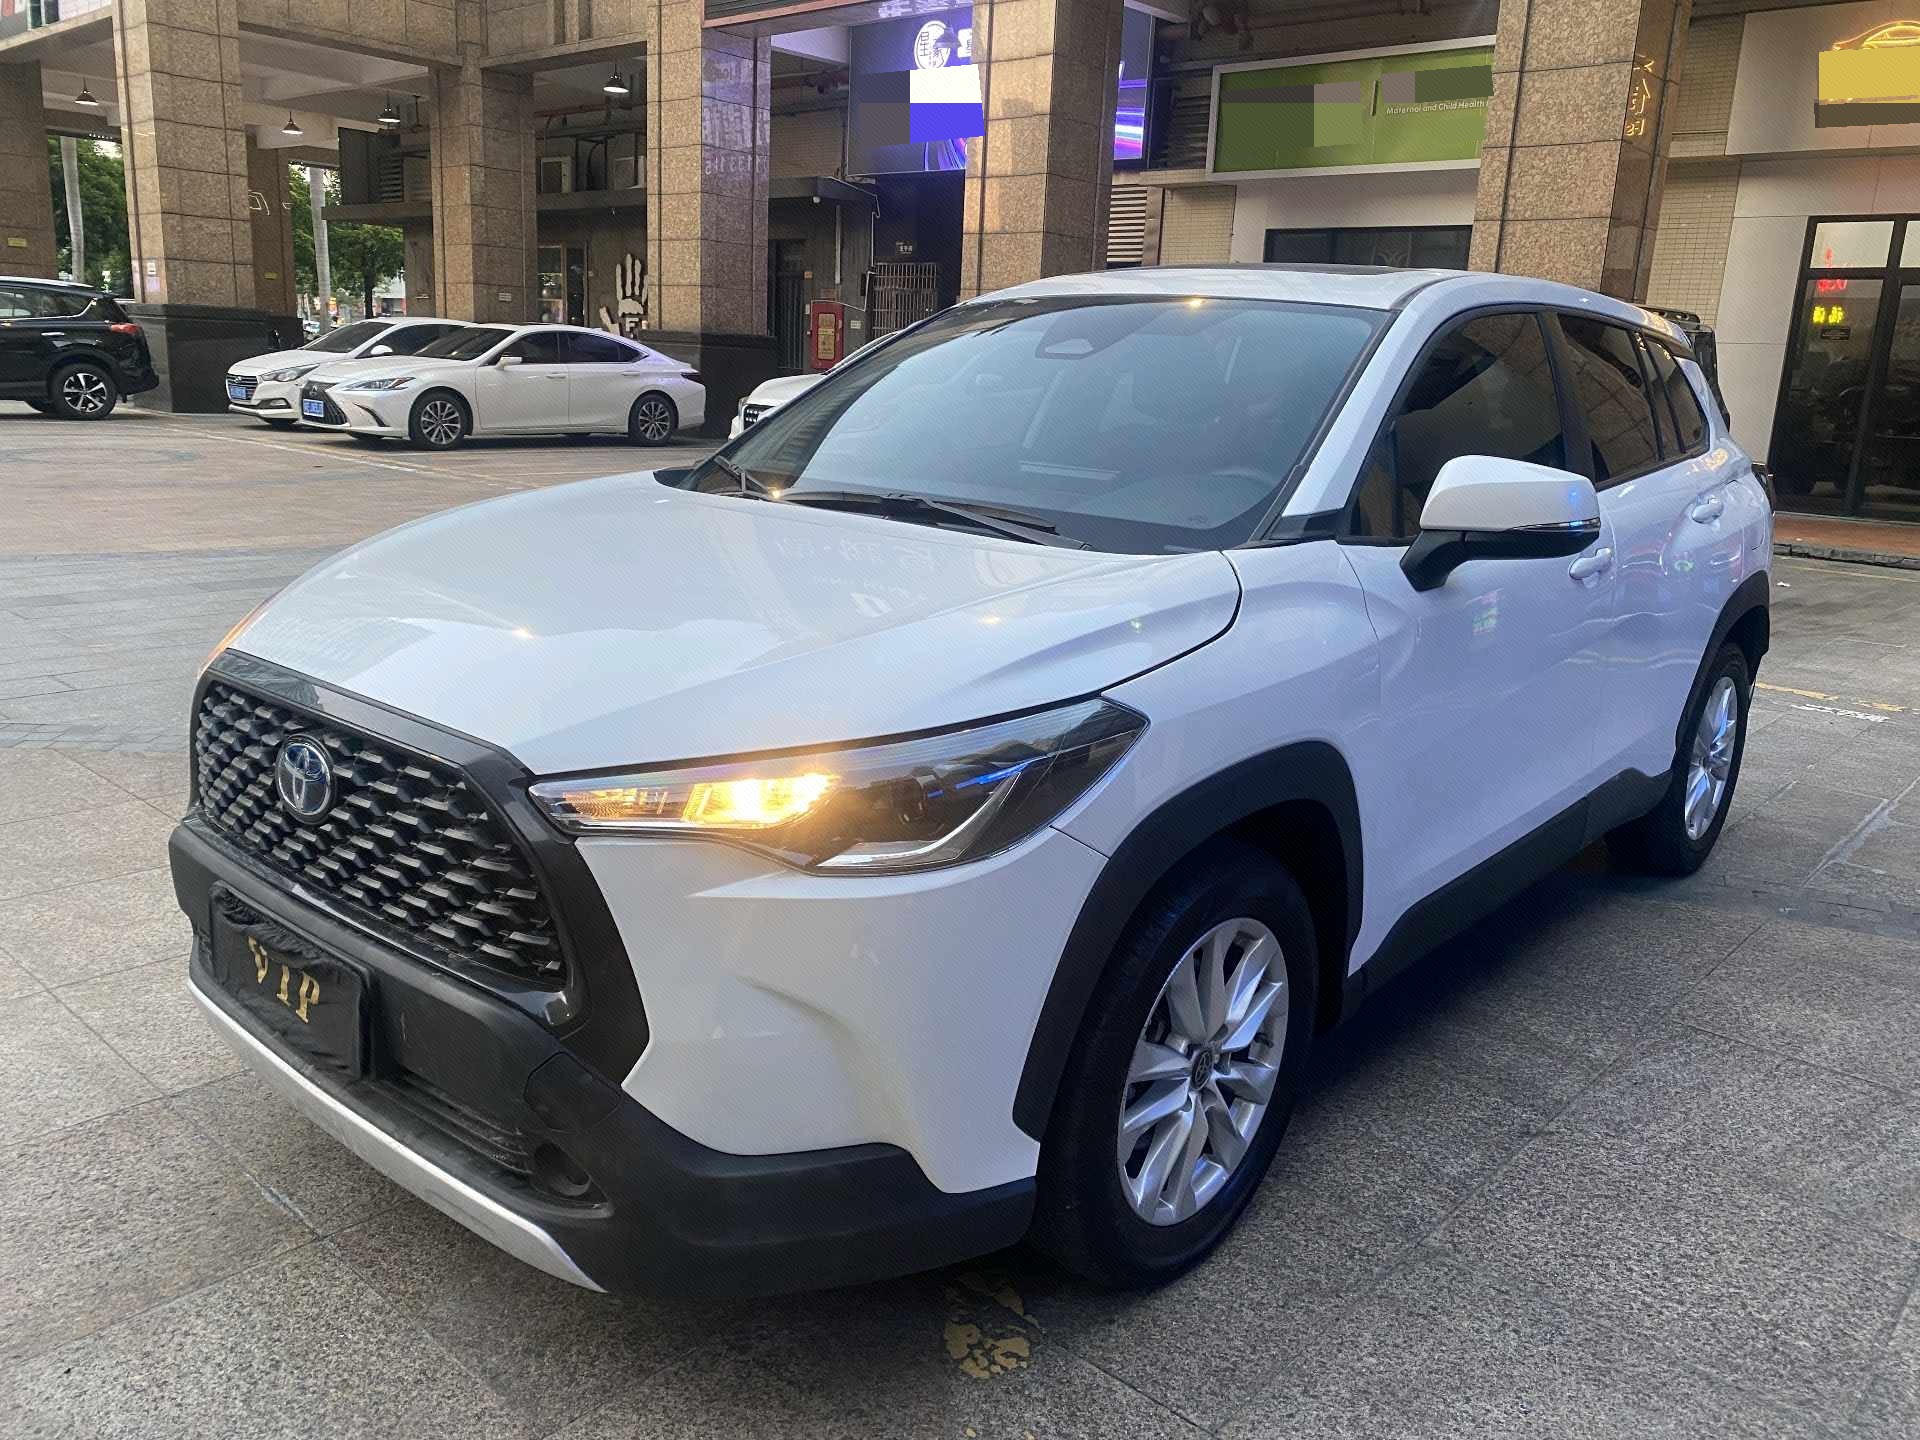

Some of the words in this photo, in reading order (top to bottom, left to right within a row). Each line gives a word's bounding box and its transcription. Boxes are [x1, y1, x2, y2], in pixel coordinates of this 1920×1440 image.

[1386, 105, 1421, 115] Maternal
[1423, 103, 1437, 112] and
[1438, 102, 1457, 111] Child
[1457, 99, 1485, 109] Health
[248, 935, 320, 1024] VIP
